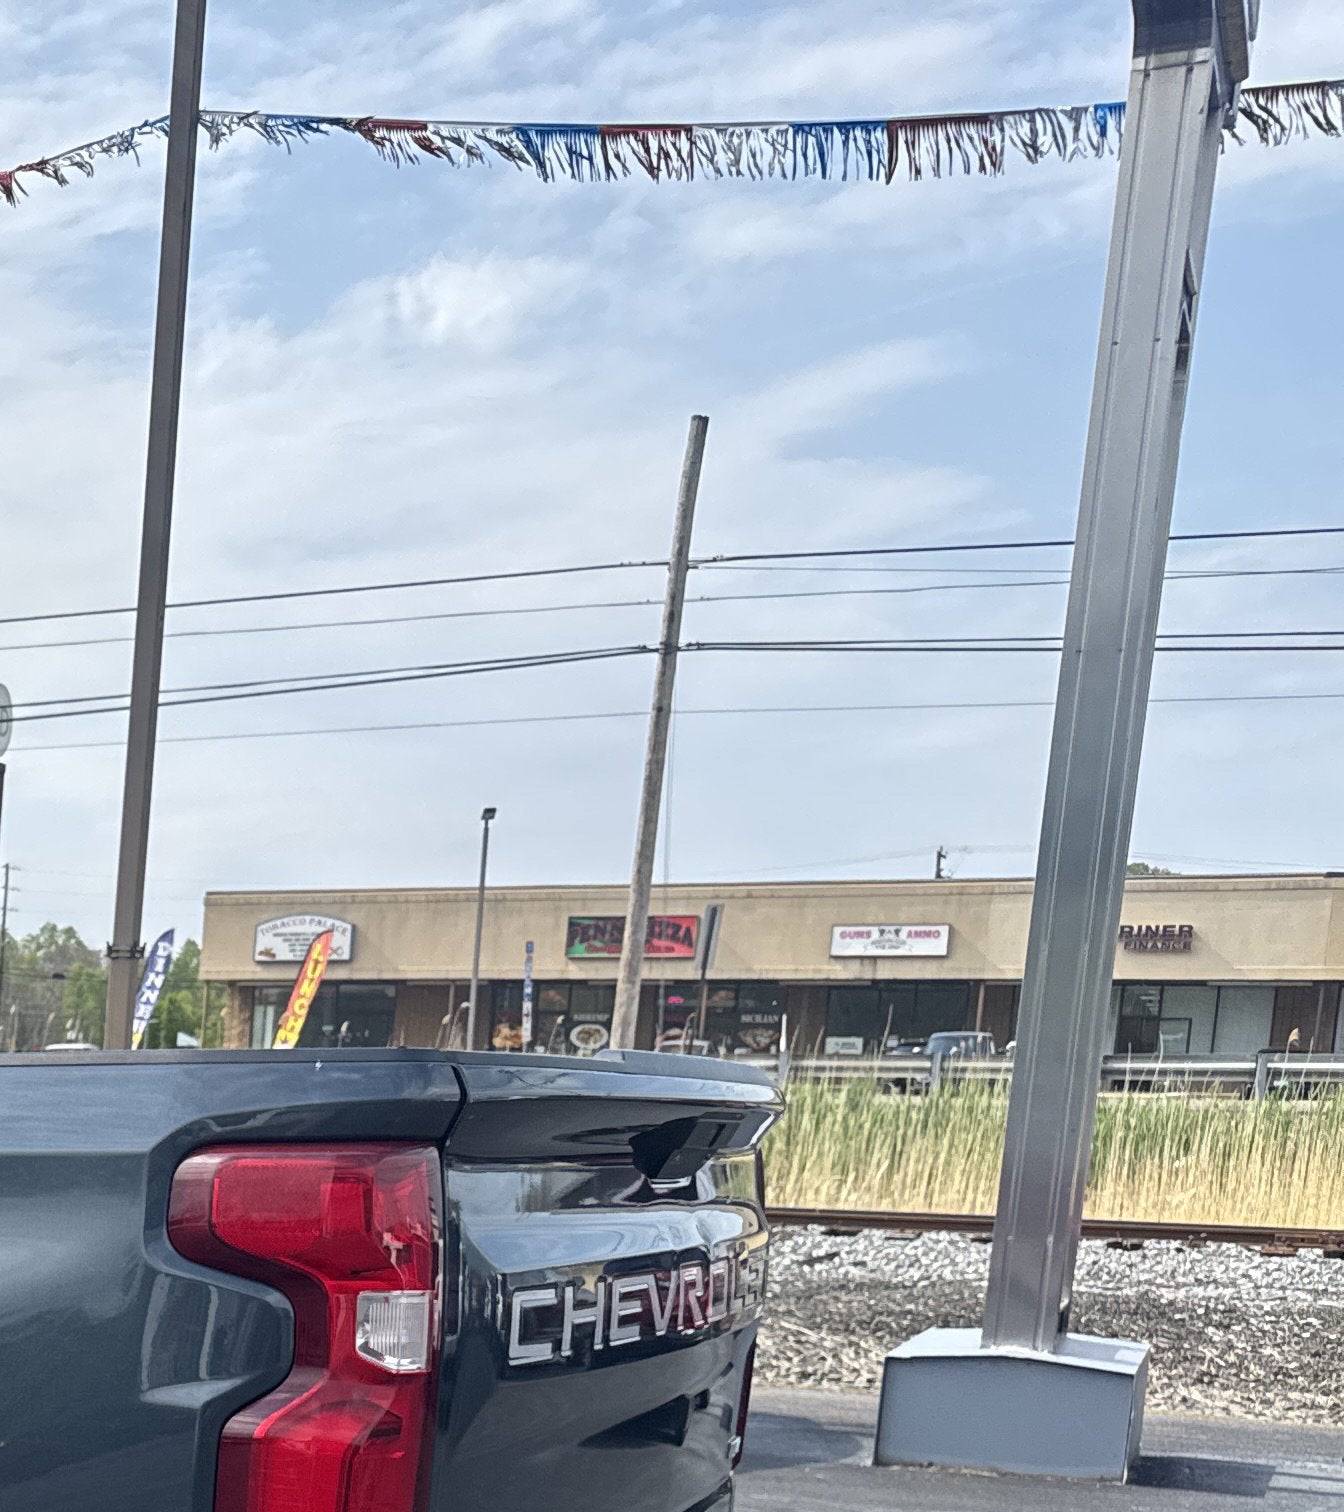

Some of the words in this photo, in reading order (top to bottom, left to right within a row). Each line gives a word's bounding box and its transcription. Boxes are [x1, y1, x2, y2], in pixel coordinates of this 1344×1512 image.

[260, 918, 307, 937] TOBACCO
[309, 918, 348, 938] PALACE
[1119, 924, 1194, 938] RINER
[839, 930, 872, 940] GUNS
[906, 929, 941, 940] AMMO
[1123, 940, 1192, 951] FINANCE
